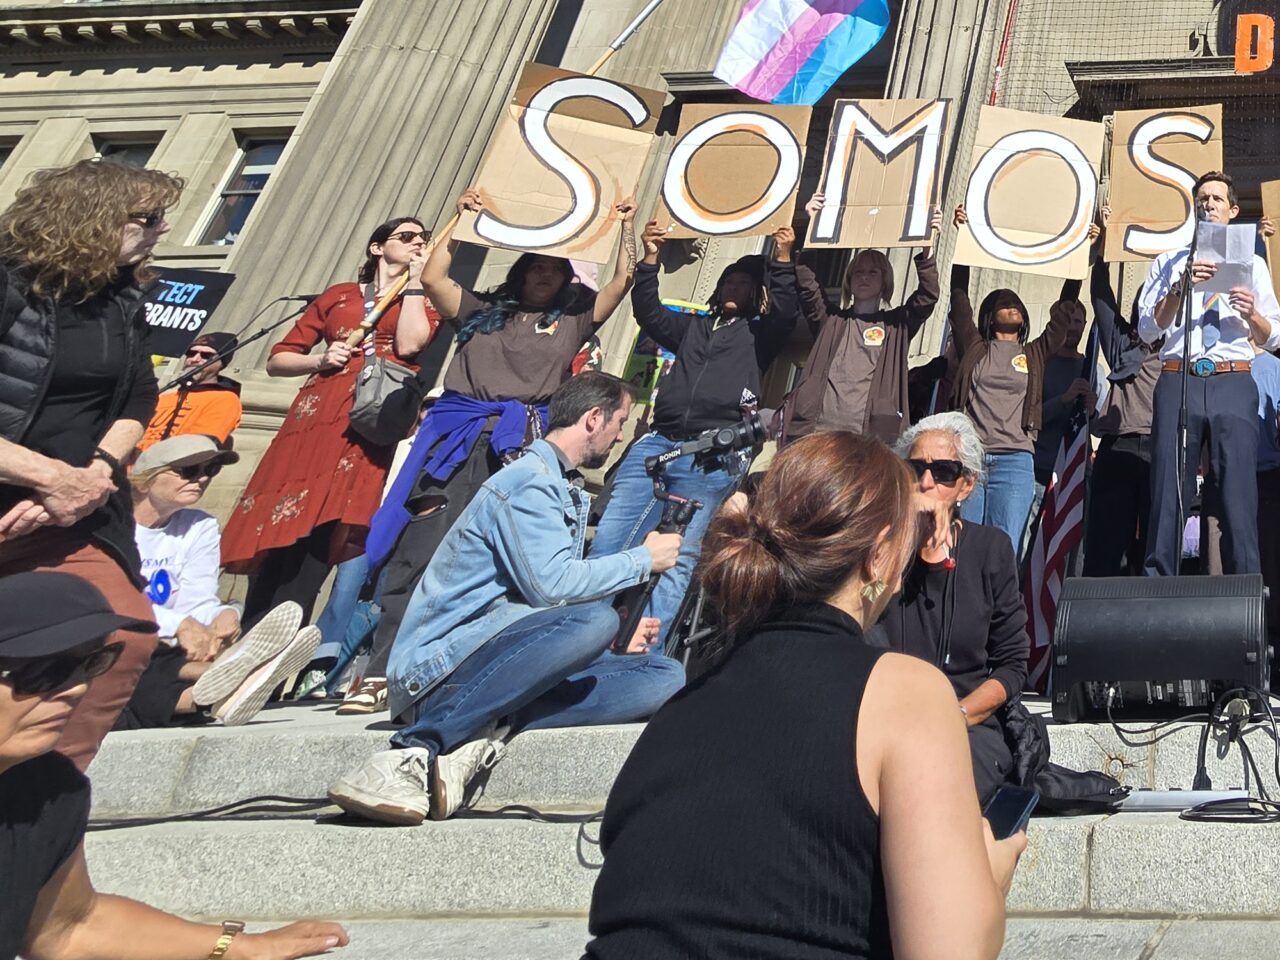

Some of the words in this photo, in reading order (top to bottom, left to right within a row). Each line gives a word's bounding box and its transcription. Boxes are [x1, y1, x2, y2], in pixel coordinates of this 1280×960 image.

[473, 76, 1215, 265] SOMOS
[157, 279, 206, 305] TECT
[659, 448, 681, 463] RONIN
